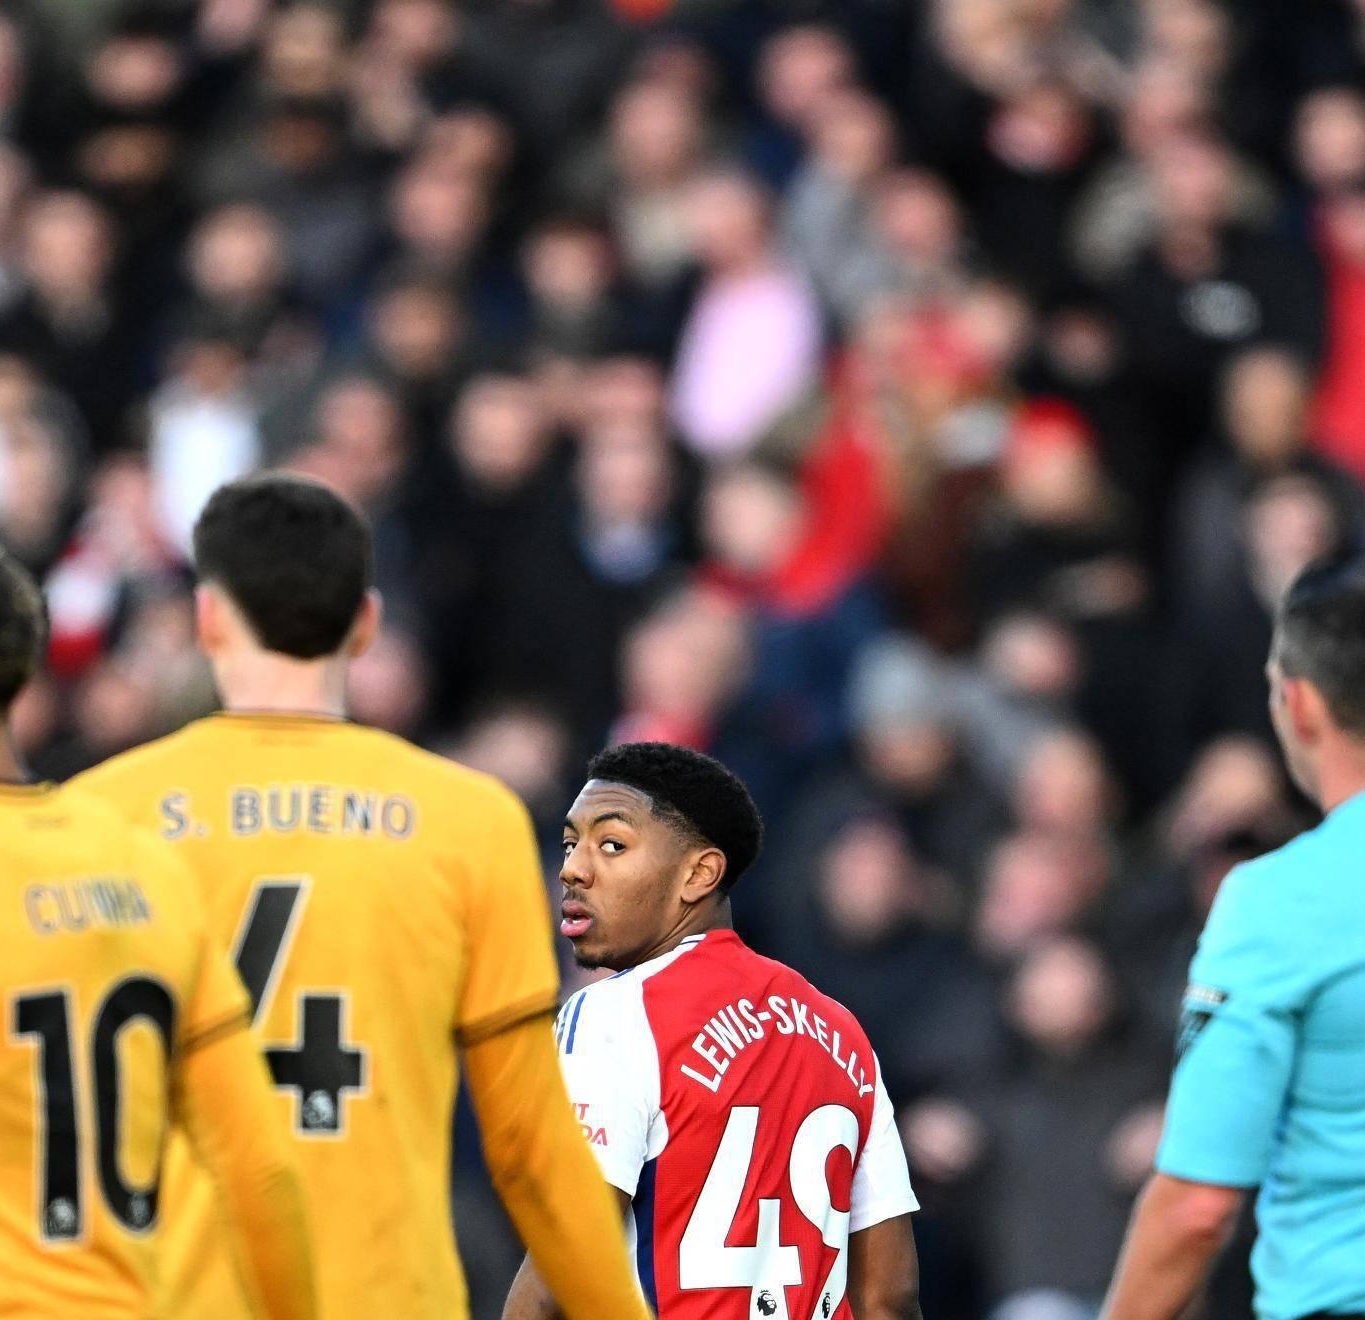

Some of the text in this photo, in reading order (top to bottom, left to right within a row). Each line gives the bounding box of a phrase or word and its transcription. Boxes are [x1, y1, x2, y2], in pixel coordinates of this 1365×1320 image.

[158, 783, 416, 842] S. BUENO
[232, 878, 367, 1138] 4
[680, 995, 875, 1098] LEWIS-SKELLY
[12, 973, 178, 1243] 10
